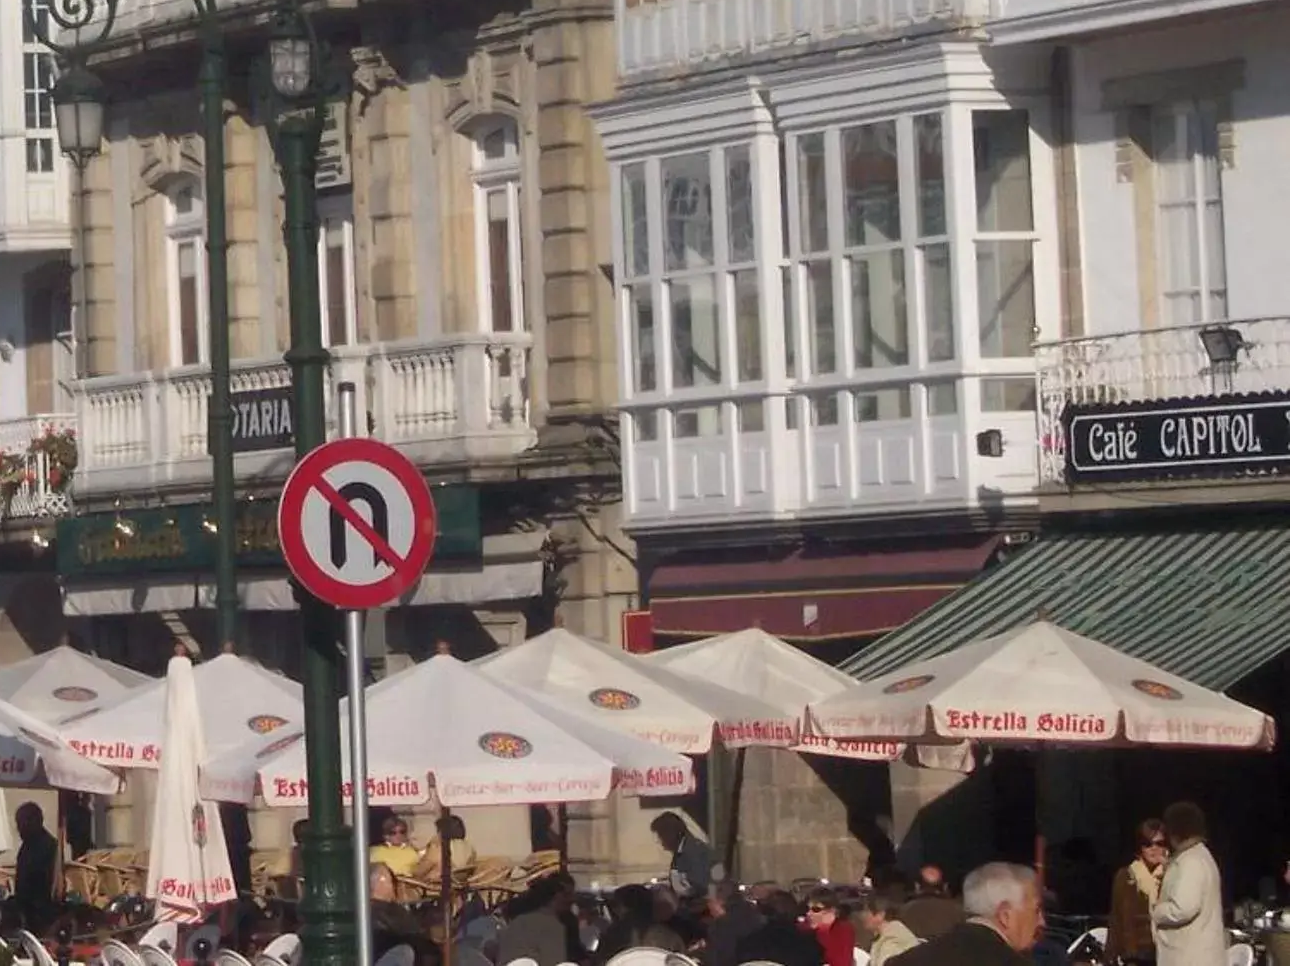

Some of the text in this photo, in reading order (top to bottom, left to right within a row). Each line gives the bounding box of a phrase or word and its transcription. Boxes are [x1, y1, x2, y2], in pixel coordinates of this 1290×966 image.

[1160, 413, 1261, 458] CAPITOL
[946, 709, 1026, 731] Estrella
[1037, 712, 1106, 733] Galicia
